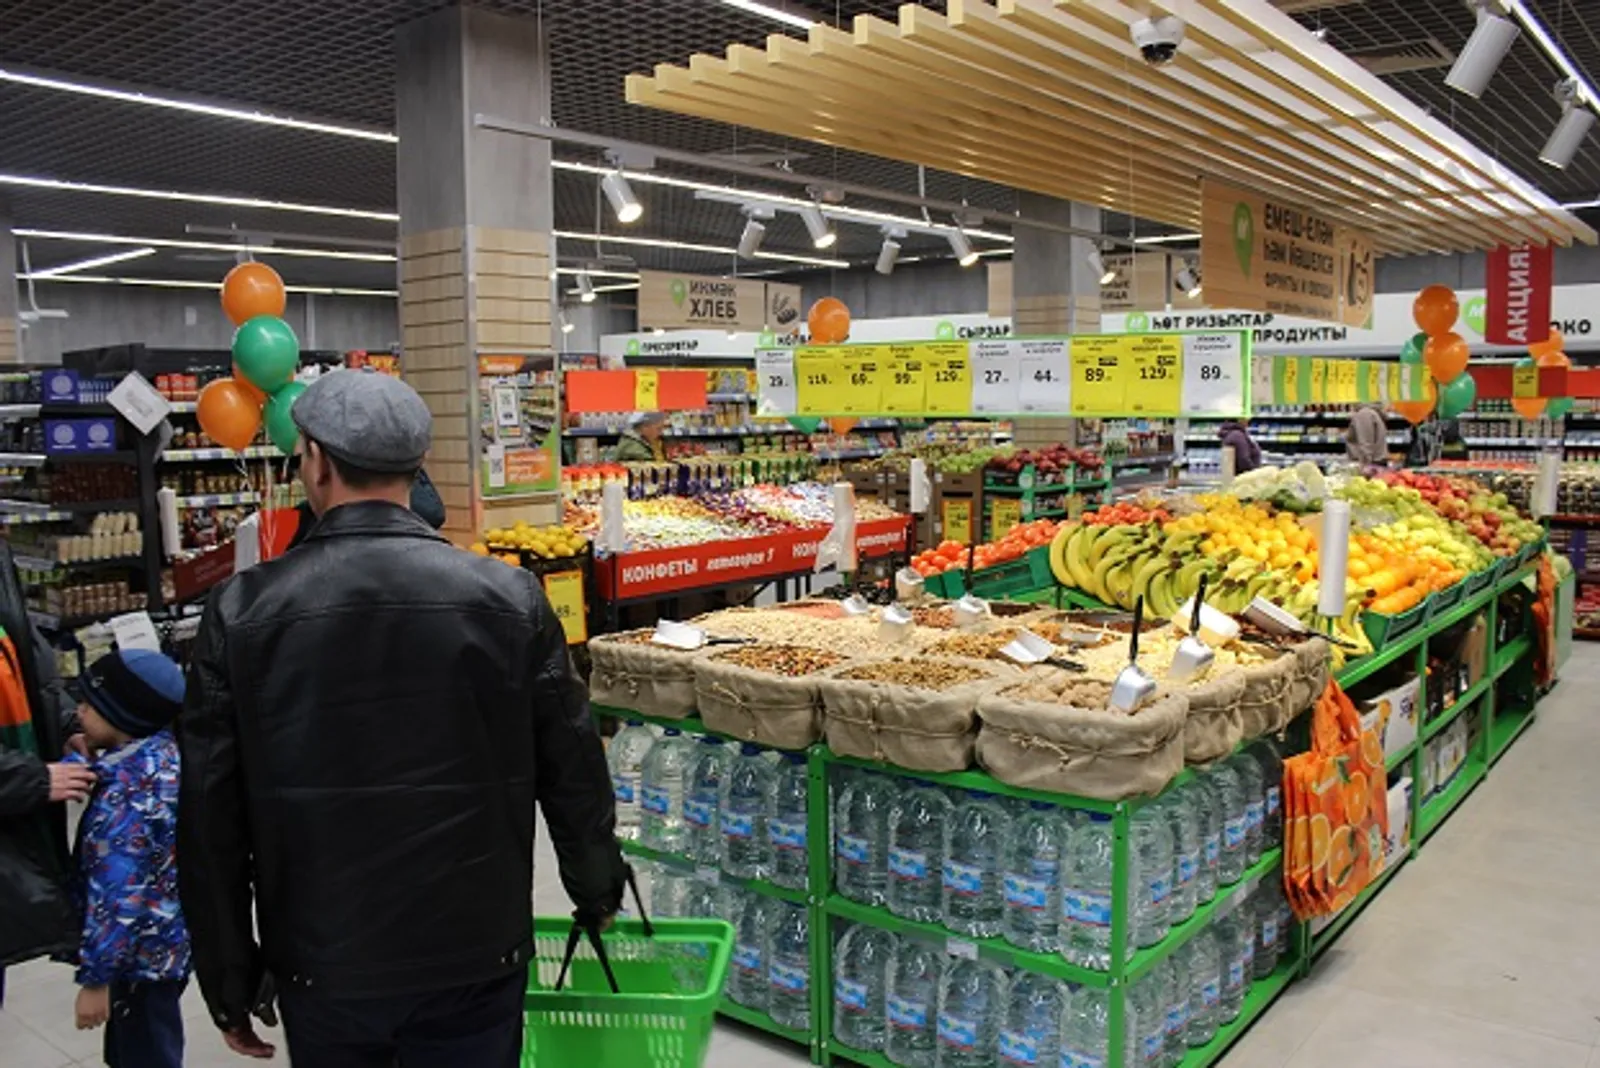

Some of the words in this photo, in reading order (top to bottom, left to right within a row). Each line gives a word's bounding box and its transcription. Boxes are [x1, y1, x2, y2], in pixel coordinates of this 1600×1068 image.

[690, 299, 737, 318] ХЛЕБ
[1252, 326, 1348, 344] ПРОДУКТЫ
[935, 371, 958, 382] 129
[985, 370, 1002, 384] 27
[1034, 370, 1051, 382] 44
[1085, 368, 1104, 382] 89
[1139, 366, 1167, 379] 129
[1201, 366, 1221, 380] 89
[622, 559, 698, 584] КОНФЕТЫ
